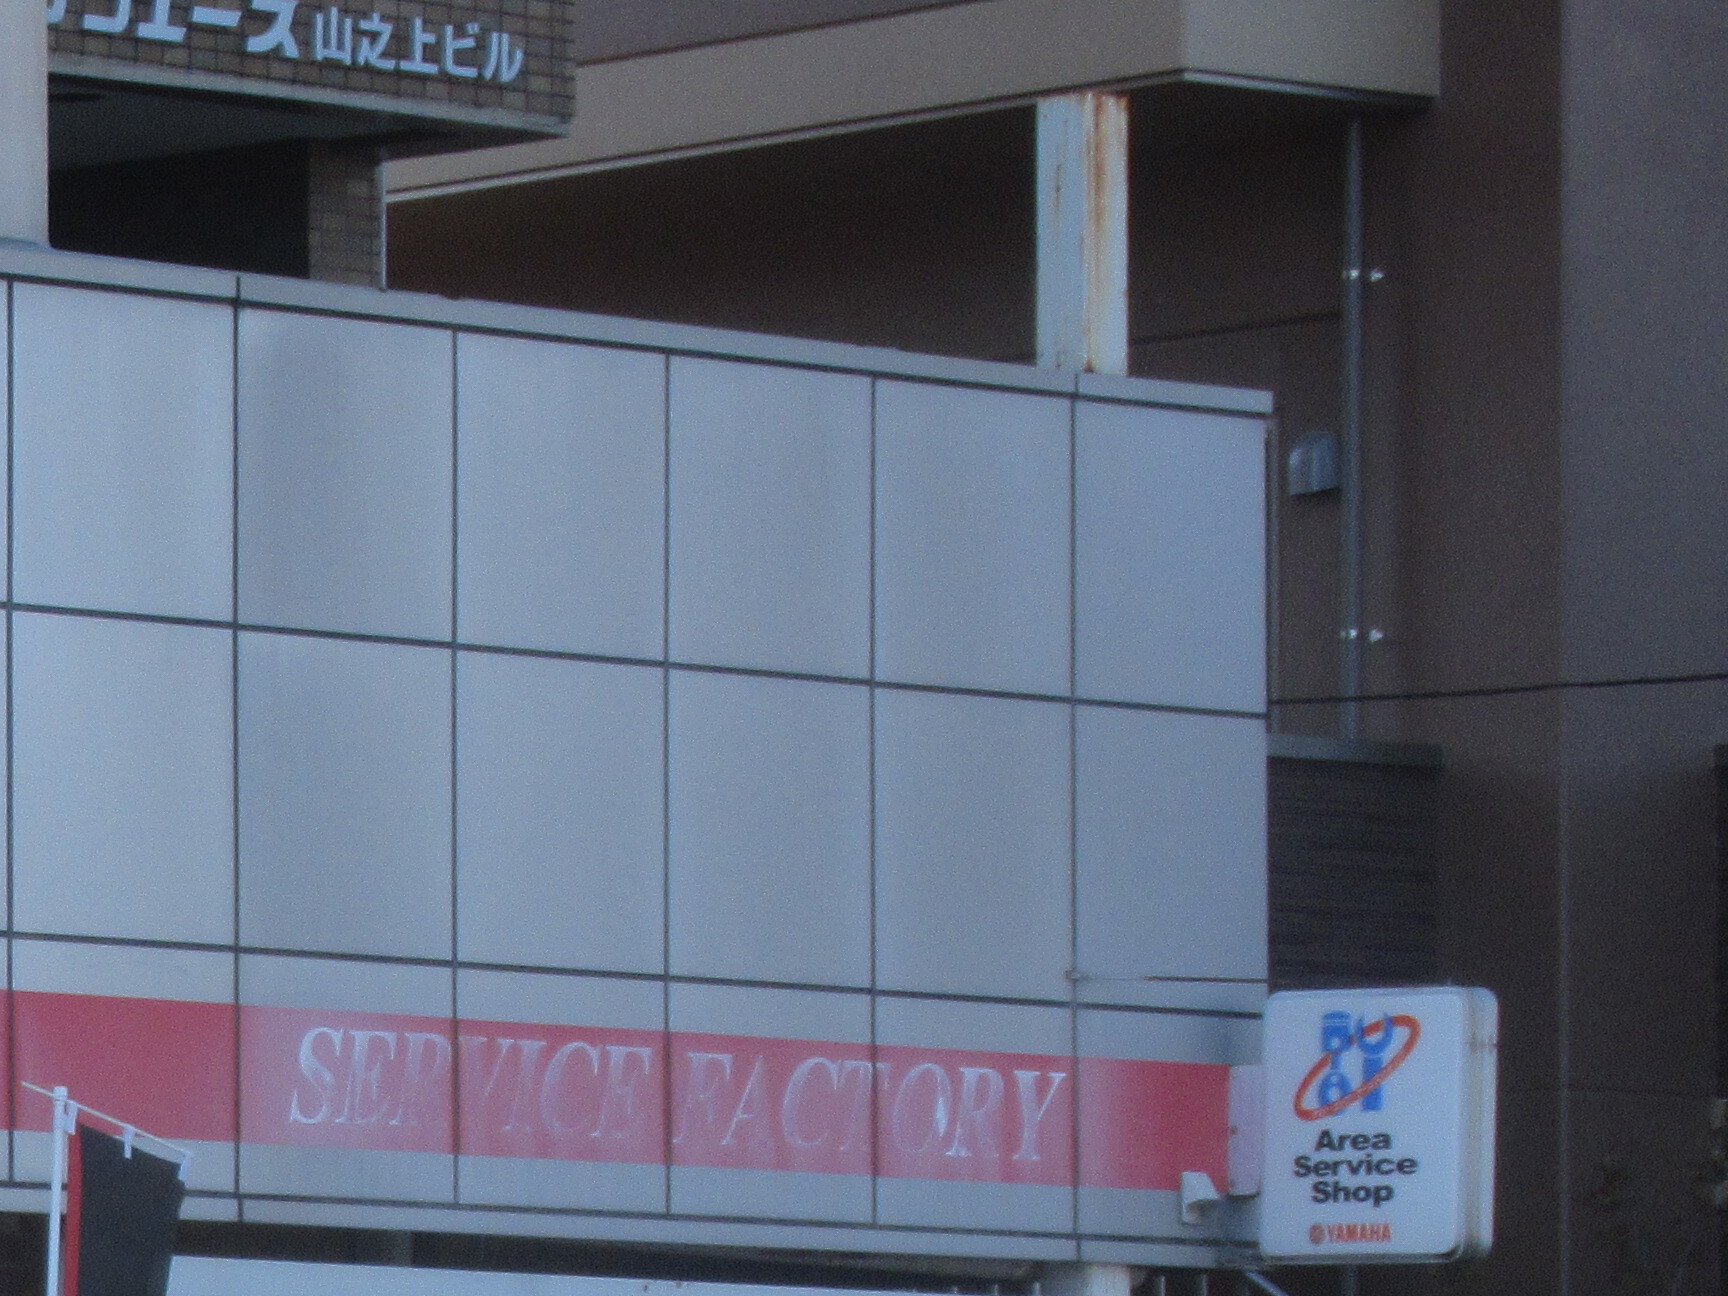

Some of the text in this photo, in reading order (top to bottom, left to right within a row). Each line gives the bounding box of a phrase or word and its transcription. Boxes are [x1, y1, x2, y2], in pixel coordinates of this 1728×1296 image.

[314, 8, 524, 84] 山之上ビル
[289, 1027, 1069, 1162] SERVICE FACTORY
[1314, 1129, 1392, 1152] Area
[1294, 1154, 1418, 1178] Service
[1310, 1181, 1394, 1208] Shop
[1327, 1222, 1391, 1243] YAMAHA
